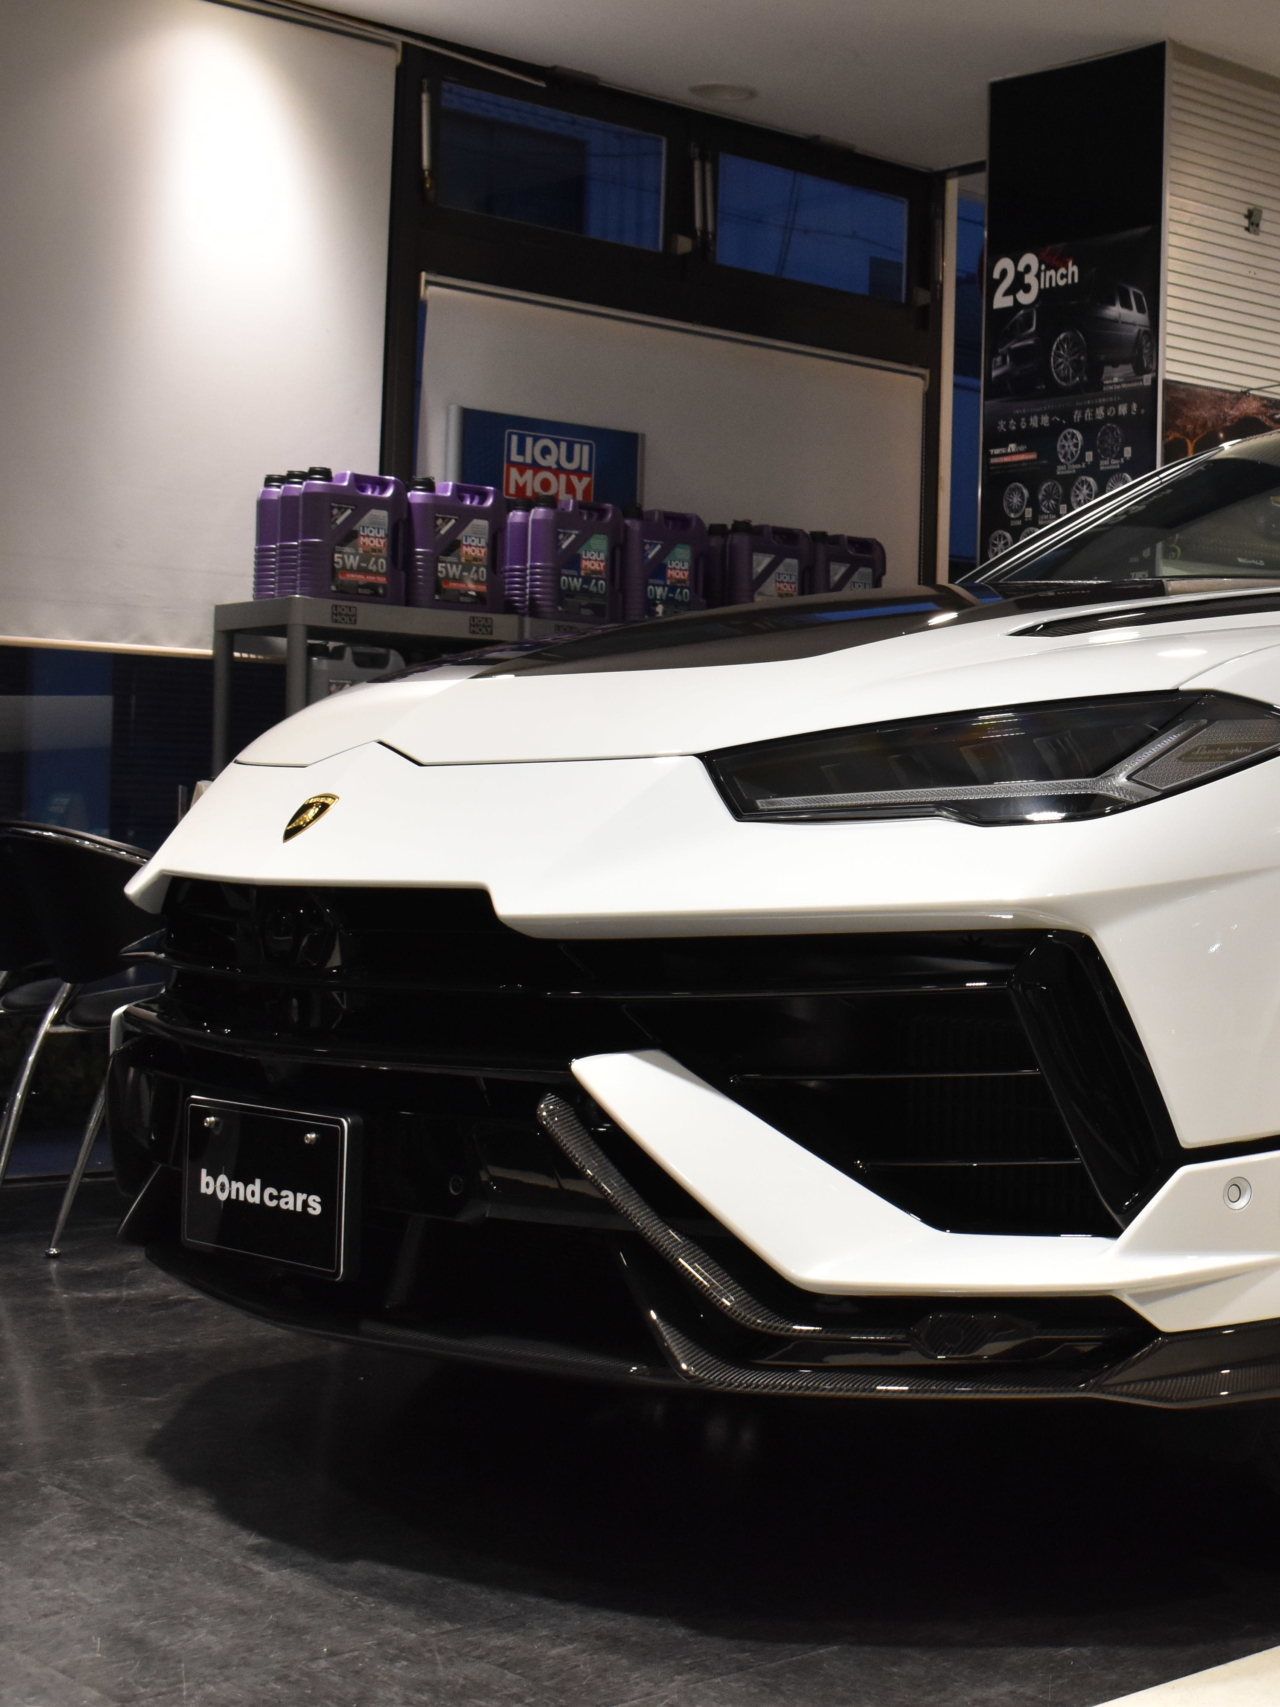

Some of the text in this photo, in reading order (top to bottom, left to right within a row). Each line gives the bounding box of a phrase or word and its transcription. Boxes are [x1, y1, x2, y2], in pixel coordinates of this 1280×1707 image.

[510, 434, 590, 471] LIQUI
[509, 467, 592, 500] MOLY
[360, 527, 385, 538] LIQUI
[360, 537, 386, 548] MOLY
[462, 536, 486, 547] LIQUI
[462, 546, 486, 556] MOLY
[582, 550, 605, 560] LIQUI
[333, 553, 387, 574] 5W-40
[582, 560, 606, 570] MOLY
[667, 560, 689, 570] LIQUI
[437, 562, 487, 582] 5W-40
[667, 569, 690, 579] MOLY
[560, 576, 607, 594] 0W-40
[776, 581, 797, 592] MOLY
[646, 585, 691, 602] 0W-40
[332, 605, 357, 615] LIQUI
[332, 614, 357, 625] MOLY
[470, 617, 494, 627] LIQUI
[470, 626, 494, 636] MOLY
